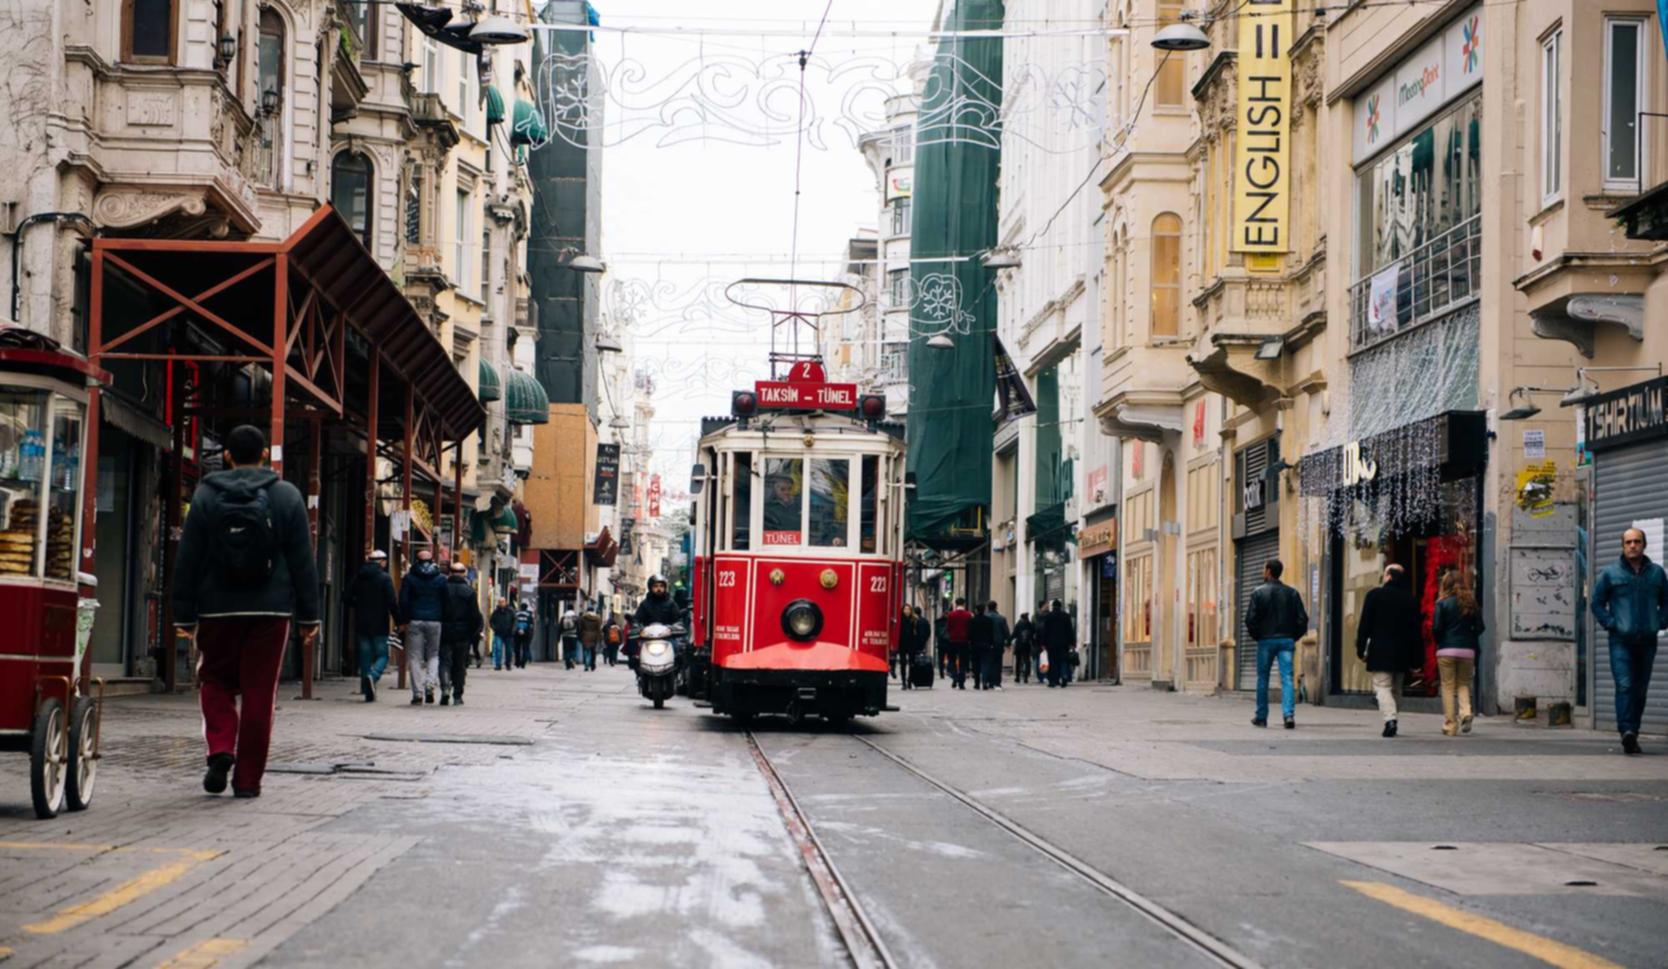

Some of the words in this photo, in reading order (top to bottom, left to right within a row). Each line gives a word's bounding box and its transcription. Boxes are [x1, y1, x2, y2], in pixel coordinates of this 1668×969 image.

[1245, 76, 1282, 246] ENGLISH
[802, 362, 811, 379] 2
[817, 386, 853, 404] TÜNEL
[718, 570, 736, 588] 223
[870, 576, 887, 593] 223
